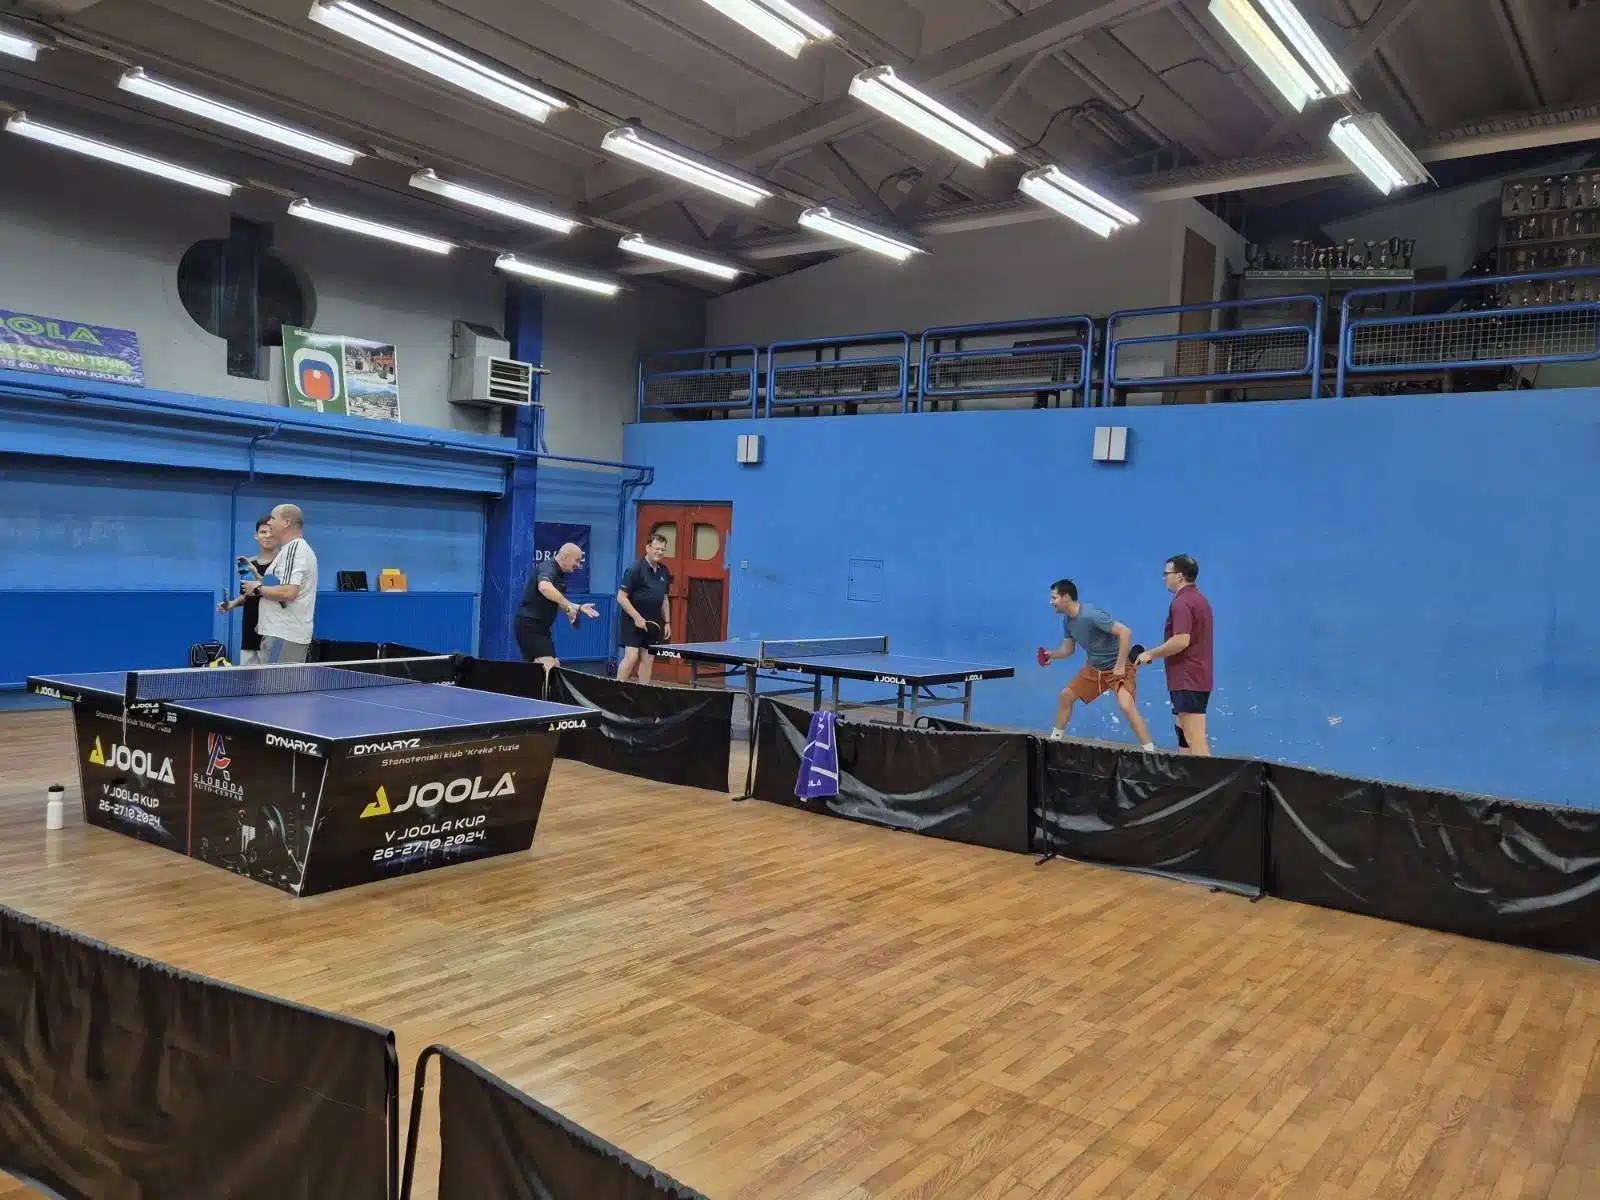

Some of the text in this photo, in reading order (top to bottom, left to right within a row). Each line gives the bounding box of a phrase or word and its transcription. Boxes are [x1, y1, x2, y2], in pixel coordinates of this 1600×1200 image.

[880, 675, 906, 685] JOOLA
[40, 686, 61, 699] JOOLA
[556, 719, 587, 731] JOOLA
[265, 733, 318, 755] DYNARYZ
[353, 738, 421, 756] DYNARYZ
[443, 750, 463, 759] klub
[498, 743, 520, 752] Tuzla
[105, 743, 176, 784] JOOLA
[193, 772, 244, 794] SLOBODA
[392, 772, 516, 813] JOOLA
[103, 784, 159, 809] V JOOLA KUP
[385, 815, 486, 842] V JOOLA KUP
